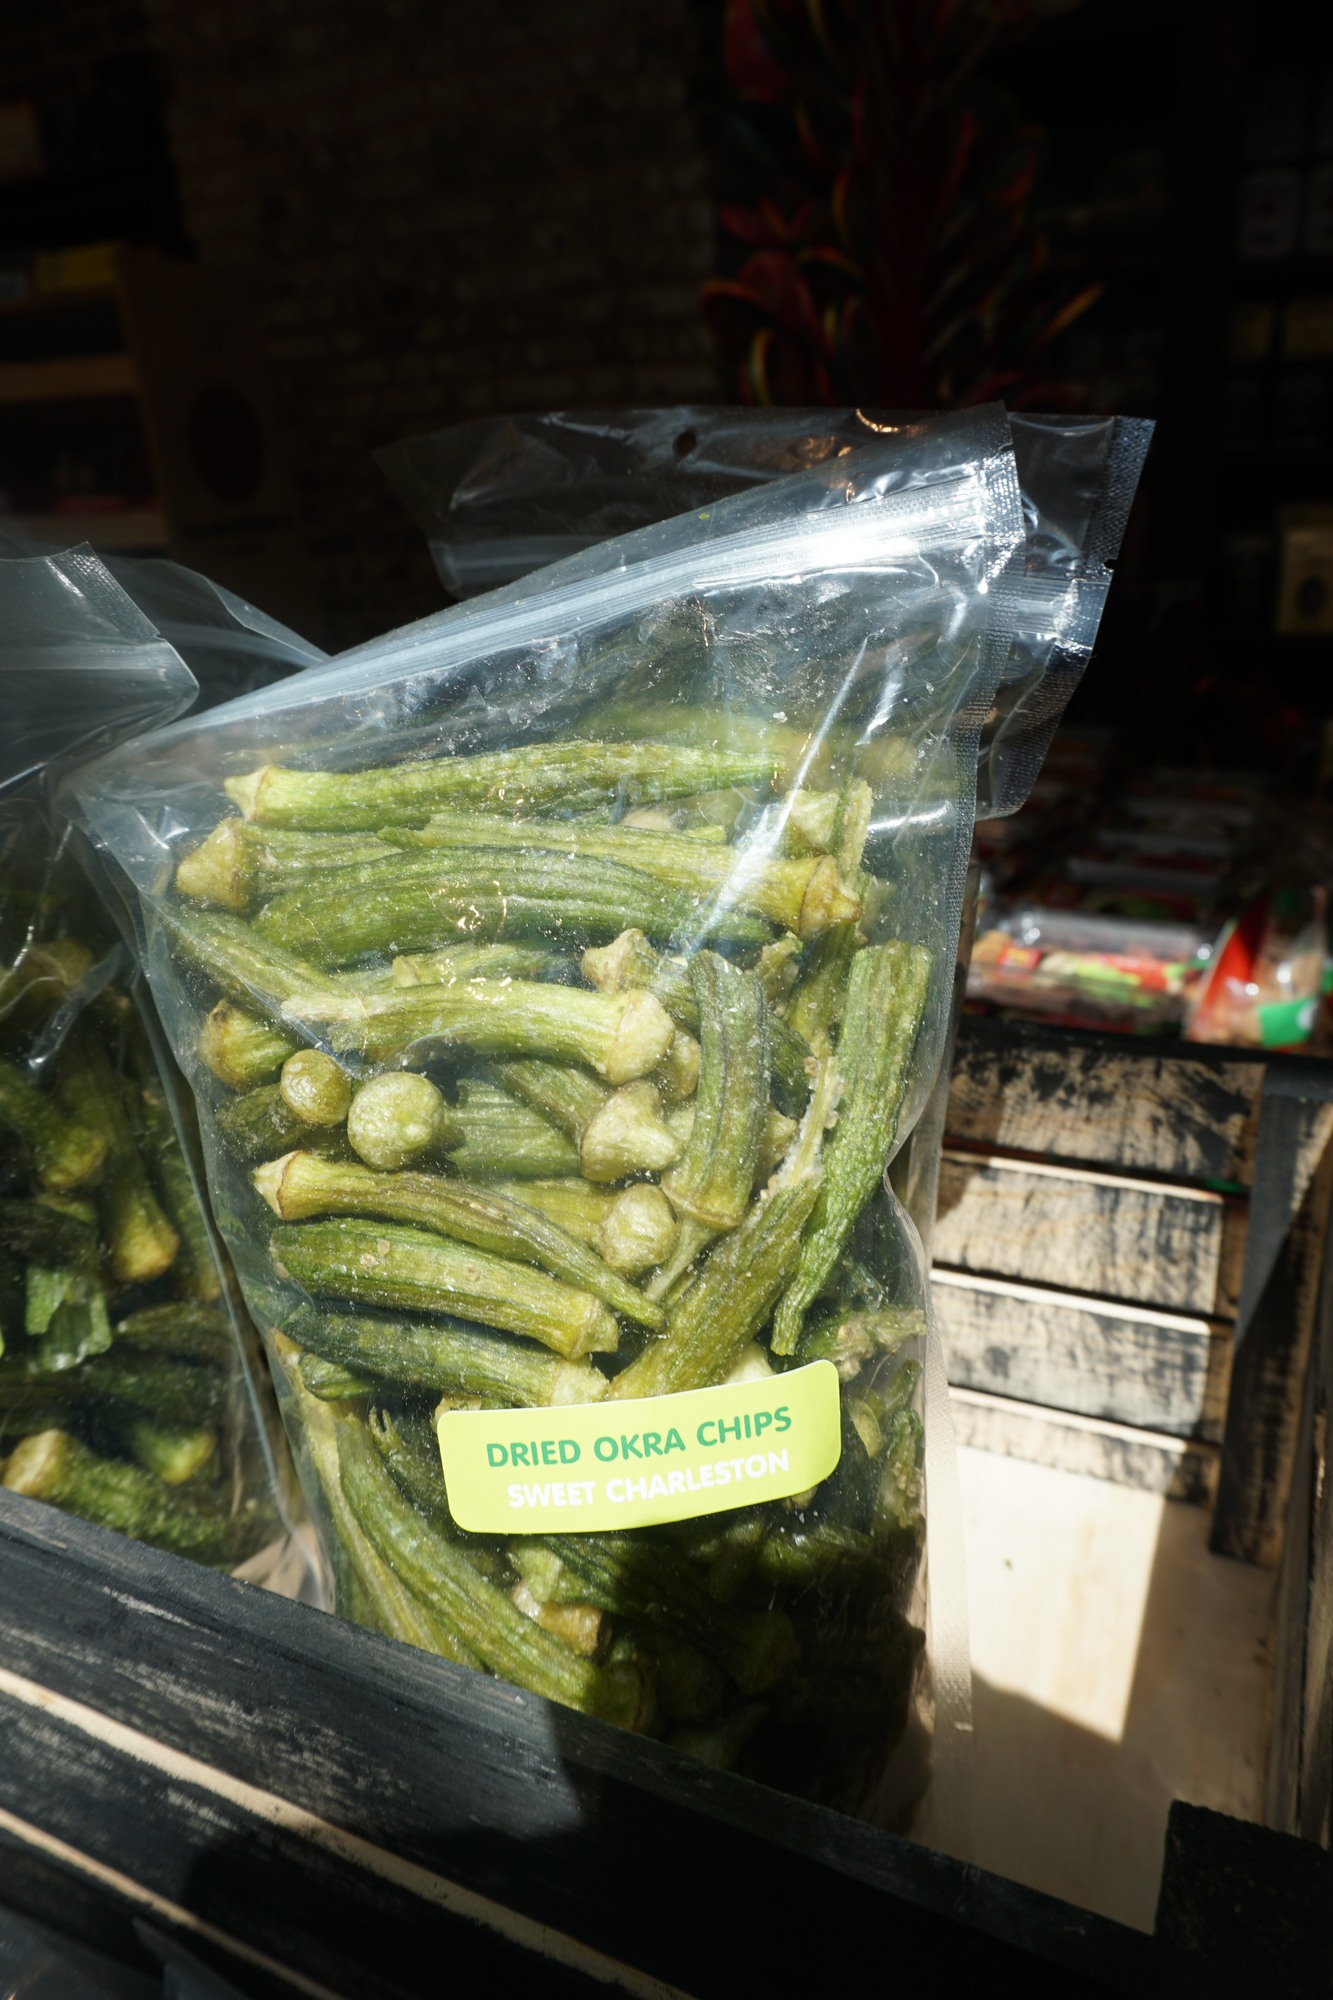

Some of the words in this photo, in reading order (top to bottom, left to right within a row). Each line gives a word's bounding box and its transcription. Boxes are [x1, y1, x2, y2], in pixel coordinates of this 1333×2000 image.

[486, 1439, 581, 1468] DRIED
[593, 1428, 686, 1463] OKRA
[696, 1406, 792, 1447] CHIPS
[507, 1481, 597, 1509] SWEET
[605, 1449, 790, 1504] CHARLESTON
